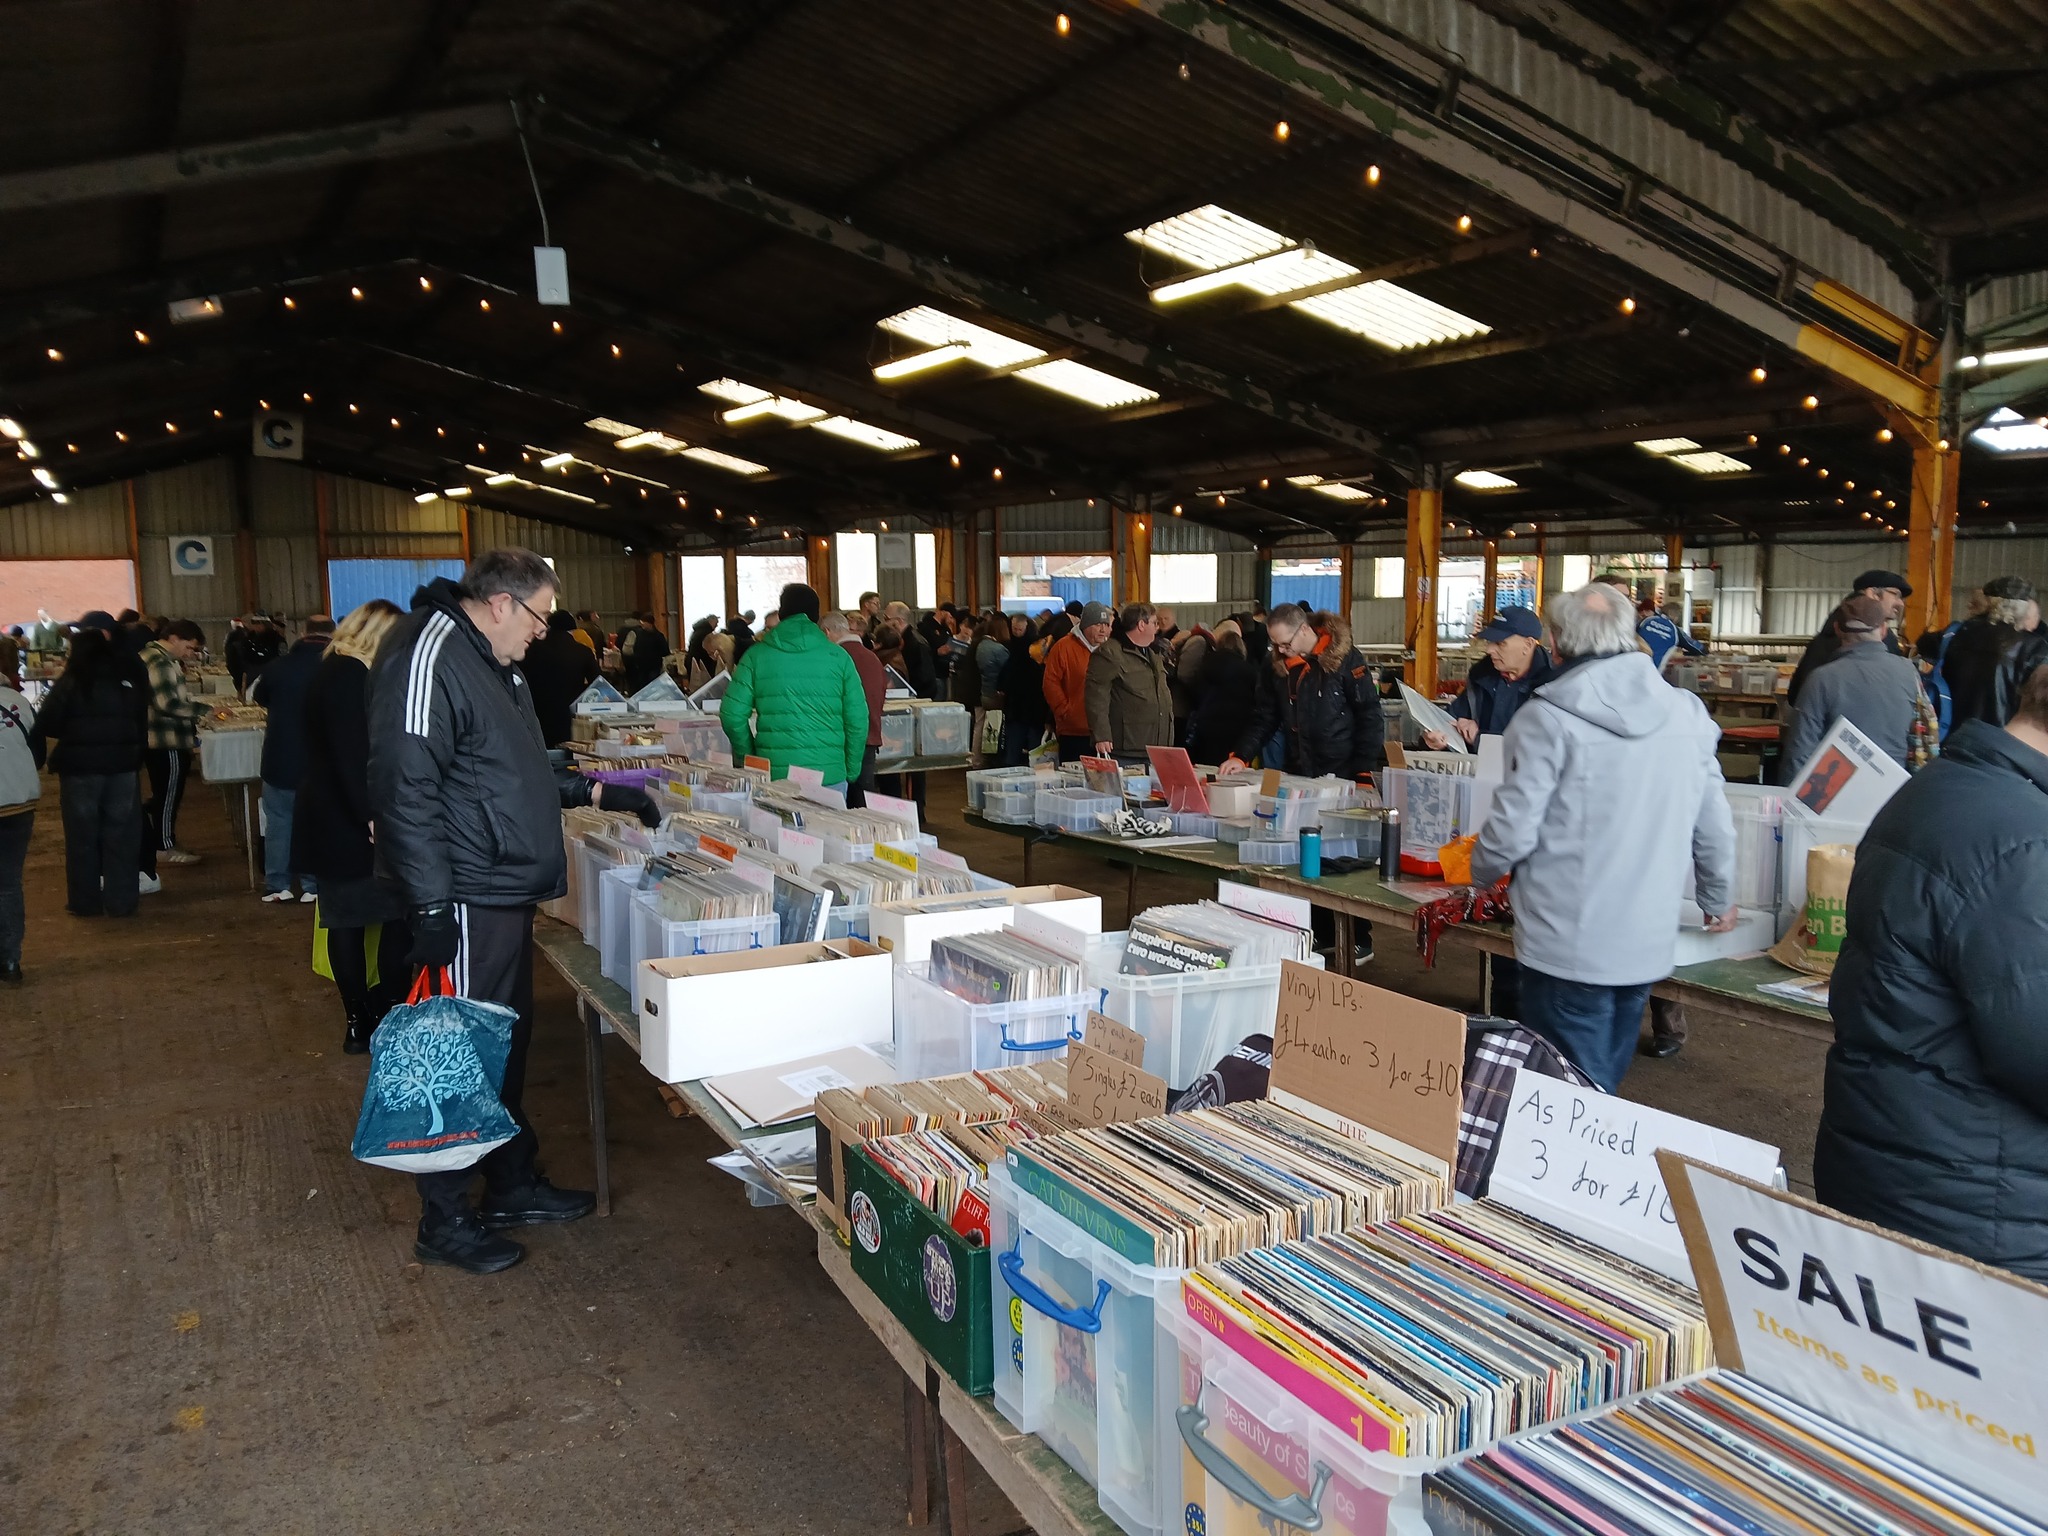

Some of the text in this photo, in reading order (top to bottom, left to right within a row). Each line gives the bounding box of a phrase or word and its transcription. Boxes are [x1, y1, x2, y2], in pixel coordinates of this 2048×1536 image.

[262, 418, 294, 449] C
[175, 539, 207, 571] C
[1286, 971, 1321, 1011] Vinyl
[1083, 1056, 1116, 1096] Singles
[1117, 1070, 1136, 1099] £2
[1141, 1088, 1162, 1109] each
[1363, 1041, 1379, 1067] 3
[1389, 1053, 1412, 1088] for
[1415, 1059, 1458, 1097] £10
[1093, 1094, 1103, 1119] 6
[1518, 1090, 1637, 1157] As Priced
[1337, 1119, 1367, 1143] THE
[1530, 1140, 1548, 1181] 3
[1572, 1163, 1609, 1202] for
[962, 1194, 984, 1220] CLIFF
[1028, 1171, 1126, 1252] CAT STEVENS
[1188, 1292, 1218, 1329] OPEN
[1732, 1226, 1982, 1380] SALE
[1753, 1309, 2037, 1460] Items as priced
[1275, 1442, 1291, 1467] of
